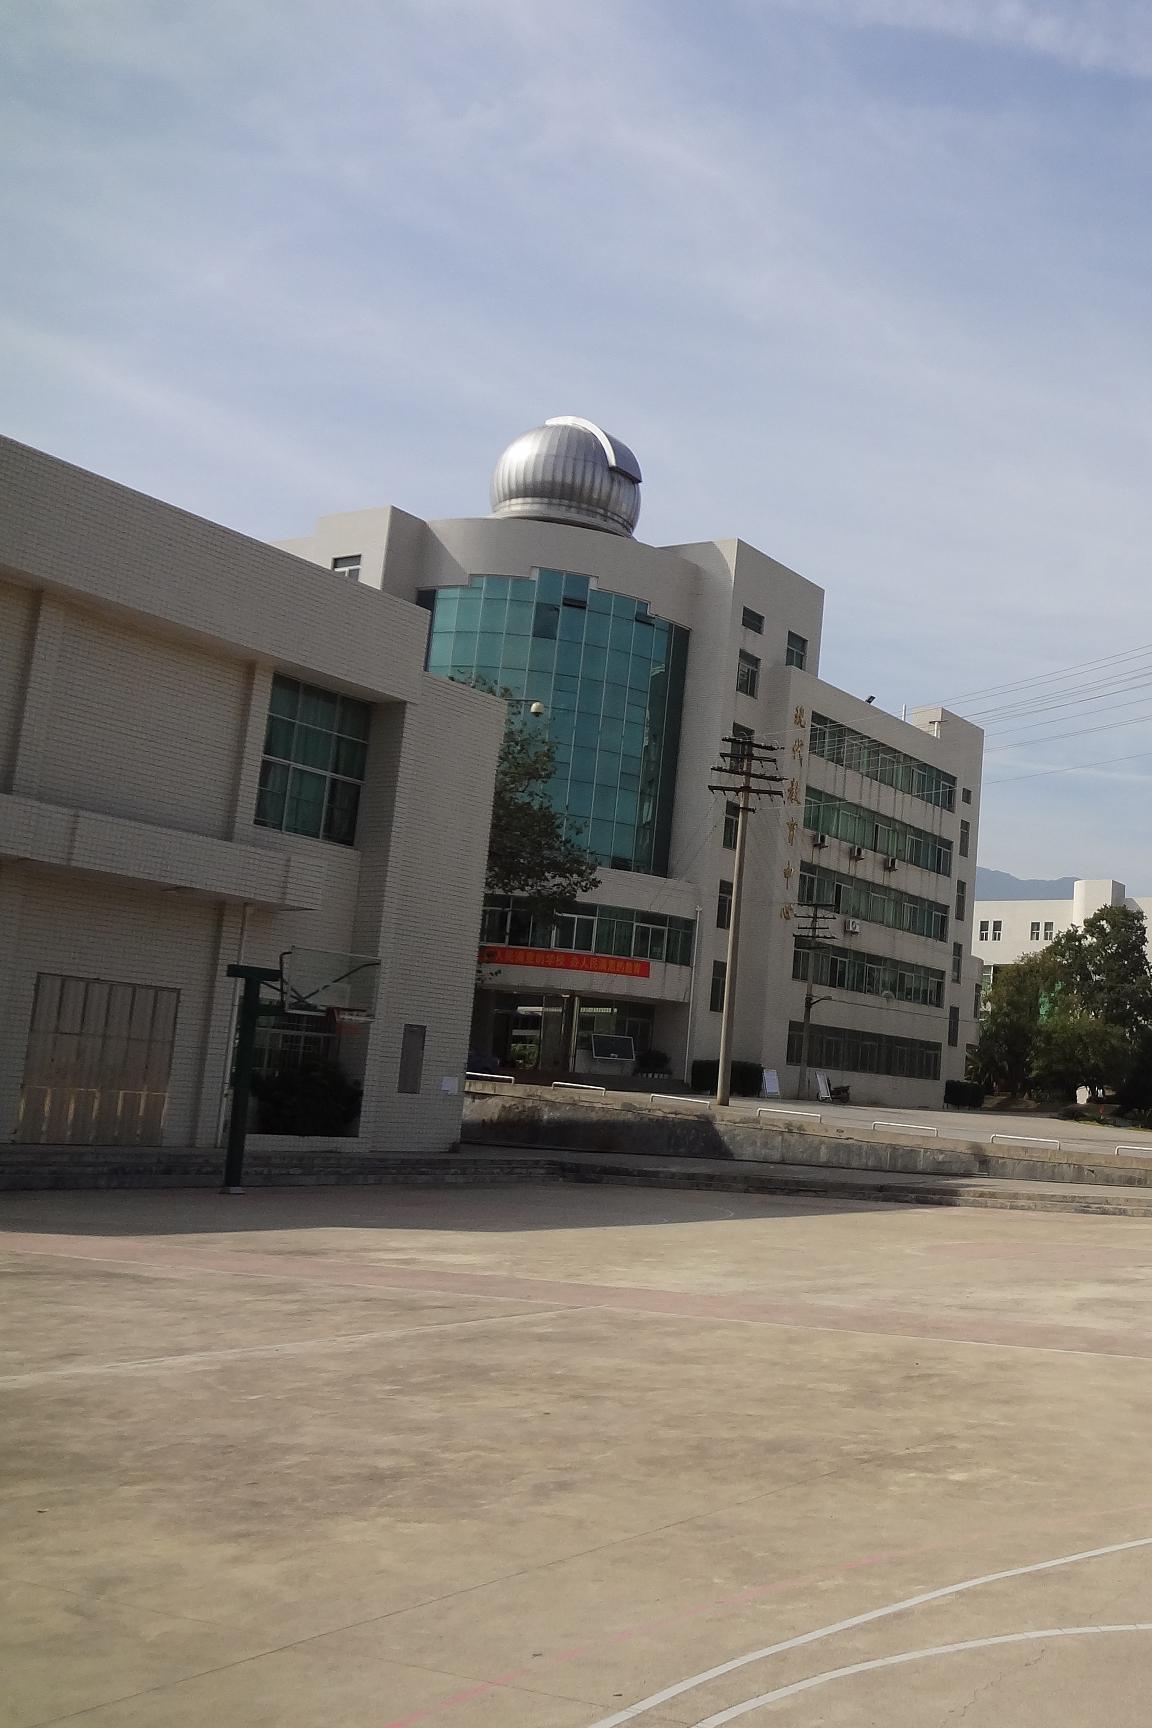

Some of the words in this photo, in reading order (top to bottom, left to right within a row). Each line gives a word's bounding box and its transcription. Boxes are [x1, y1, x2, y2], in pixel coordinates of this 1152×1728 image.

[780, 704, 806, 921] 现代教育中心
